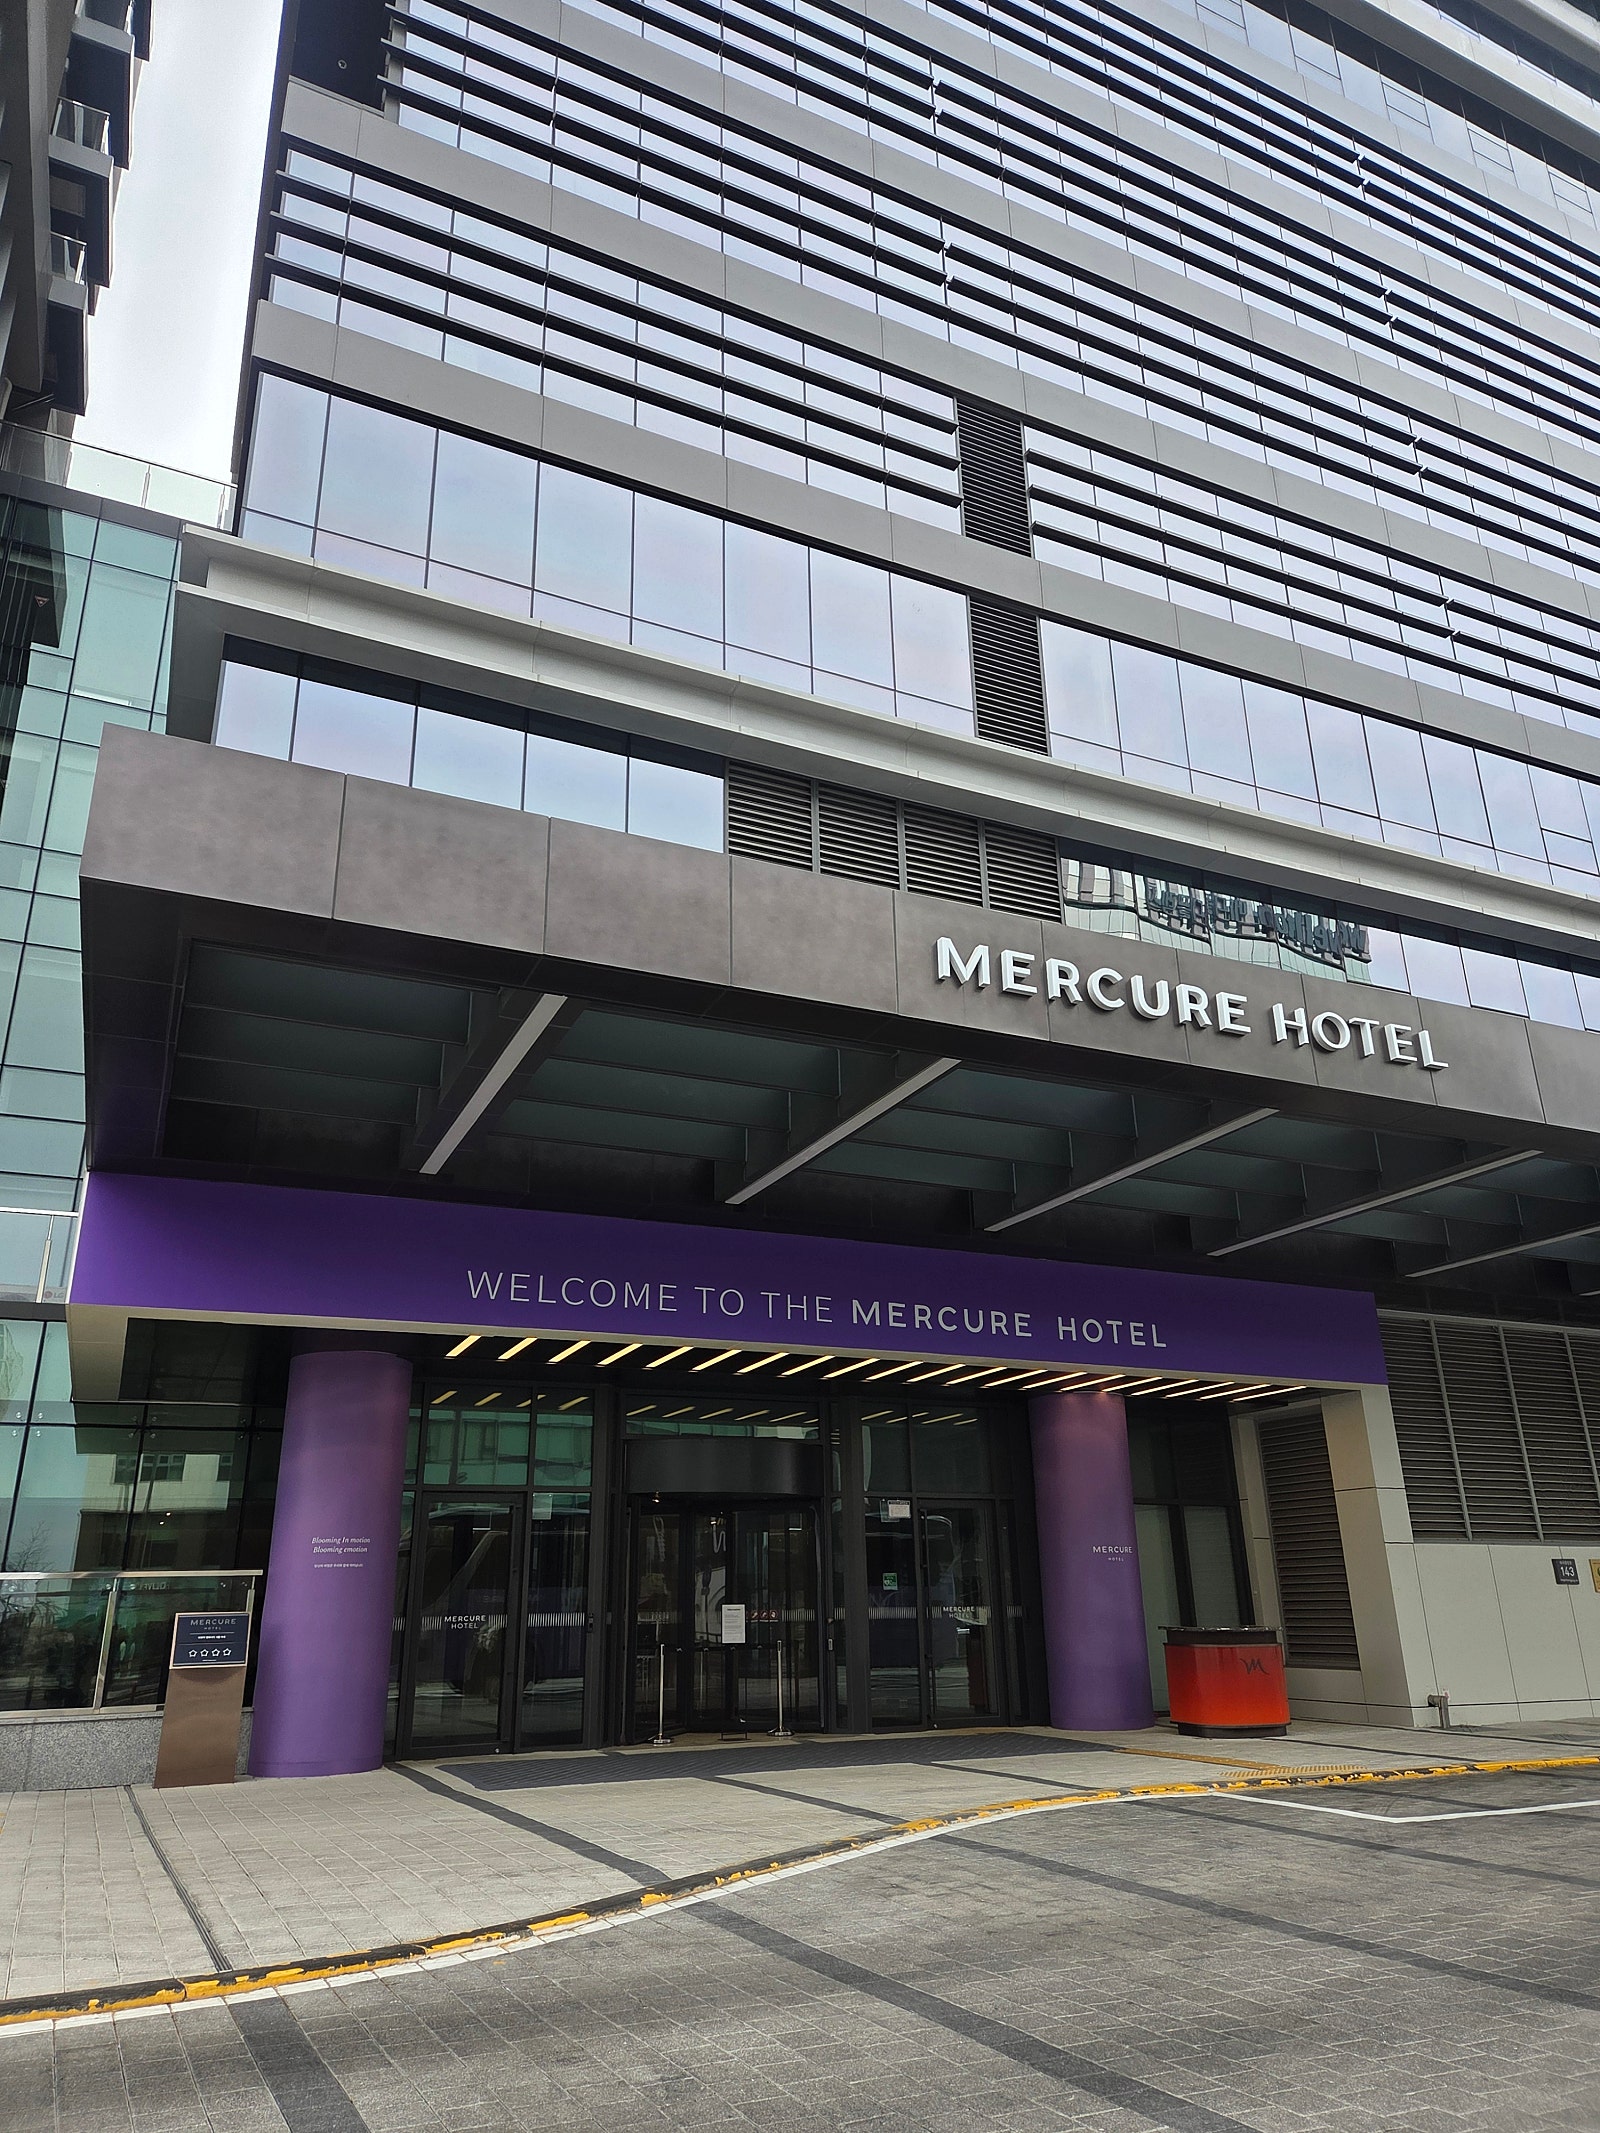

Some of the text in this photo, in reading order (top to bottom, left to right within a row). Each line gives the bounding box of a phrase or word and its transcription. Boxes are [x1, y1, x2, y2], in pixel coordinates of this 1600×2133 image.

[935, 936, 1450, 1071] MERCURE HOTEL
[467, 1270, 1168, 1348] WELCOME TO THE MERCURE HOTEL
[312, 1536, 341, 1545] Blooming
[313, 1545, 368, 1555] Blooming emotion
[1092, 1545, 1133, 1554] MERCURE
[1560, 1566, 1575, 1577] 143
[190, 1618, 237, 1626] MERCURE
[444, 1614, 487, 1623] MERCURE
[451, 1622, 479, 1630] HOTEL
